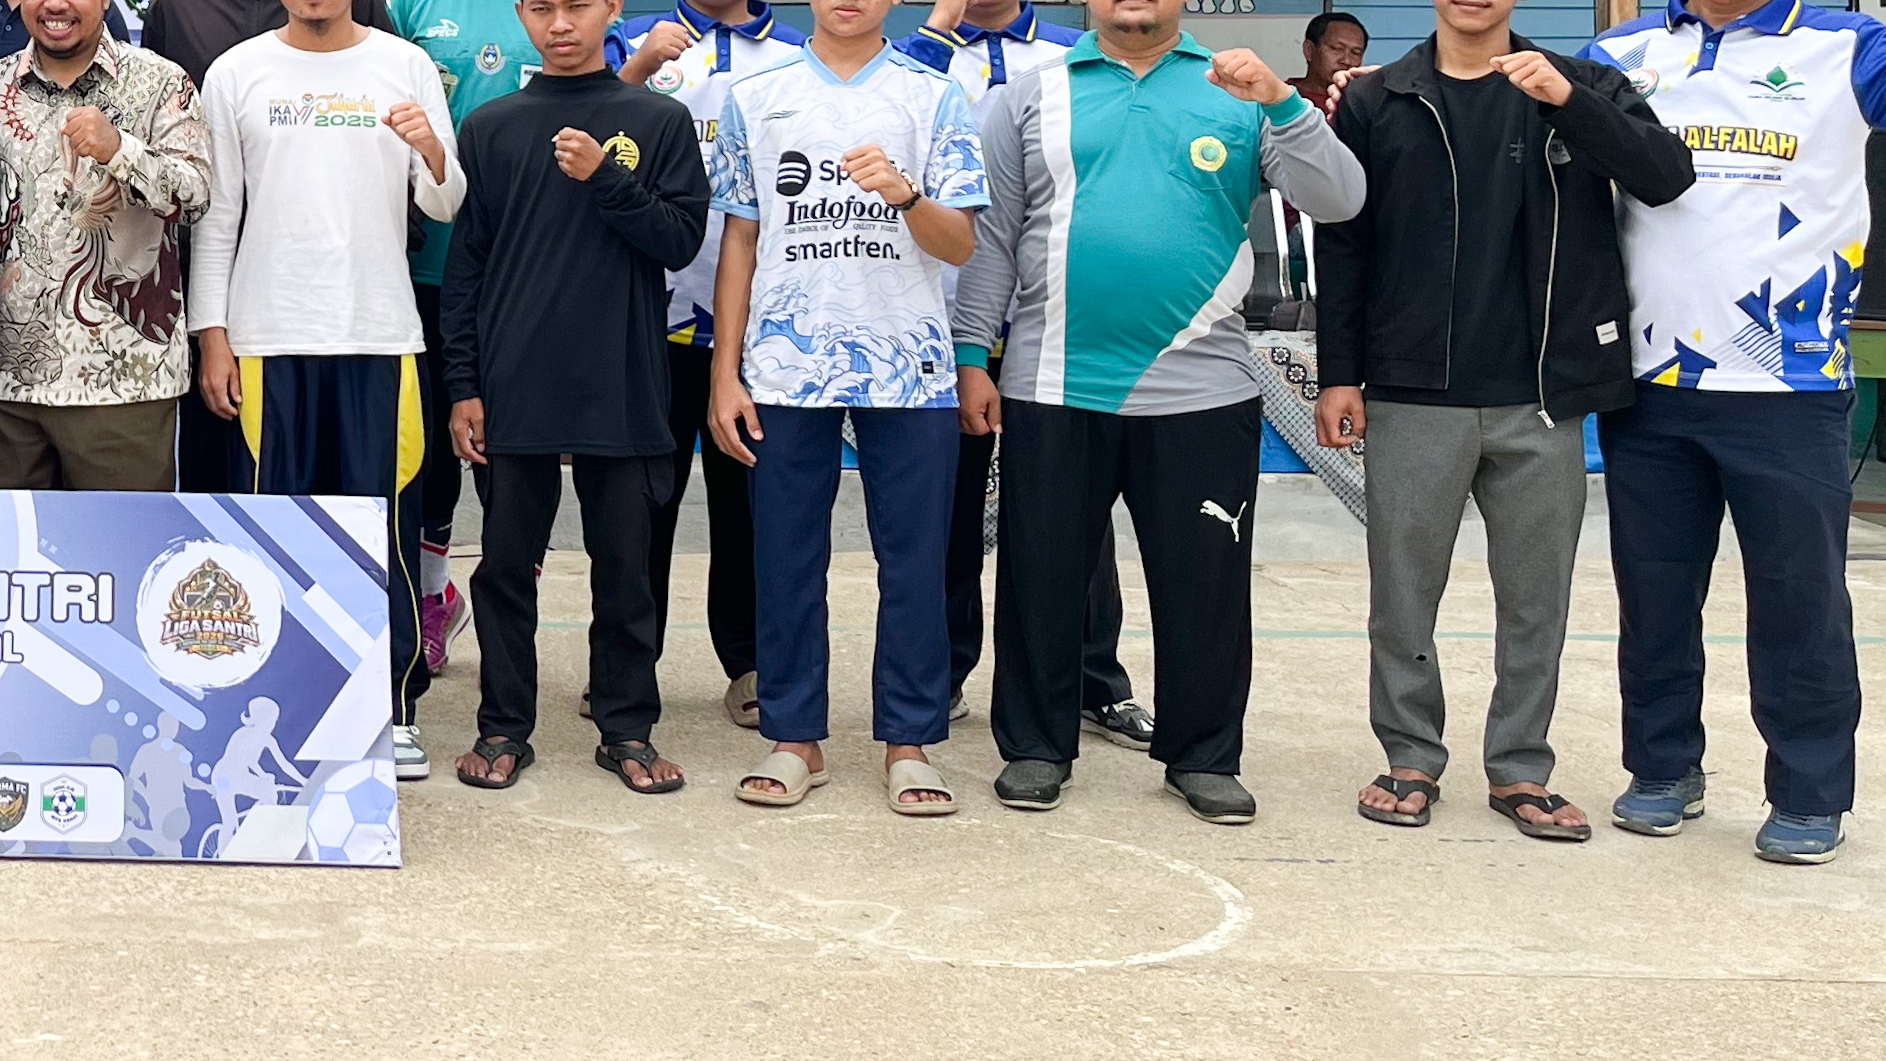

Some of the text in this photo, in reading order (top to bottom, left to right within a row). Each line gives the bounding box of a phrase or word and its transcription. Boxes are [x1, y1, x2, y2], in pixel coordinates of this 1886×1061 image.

[426, 28, 459, 38] SPECS
[270, 106, 291, 115] IKA
[270, 115, 376, 127] PMII 2025
[1684, 126, 1797, 161] AL-FALAH
[784, 195, 899, 229] Indofood
[785, 234, 900, 262] smartfren.
[180, 610, 241, 621] FUTSAL
[164, 619, 257, 642] LIGA SANTRI
[16, 784, 27, 795] FC
